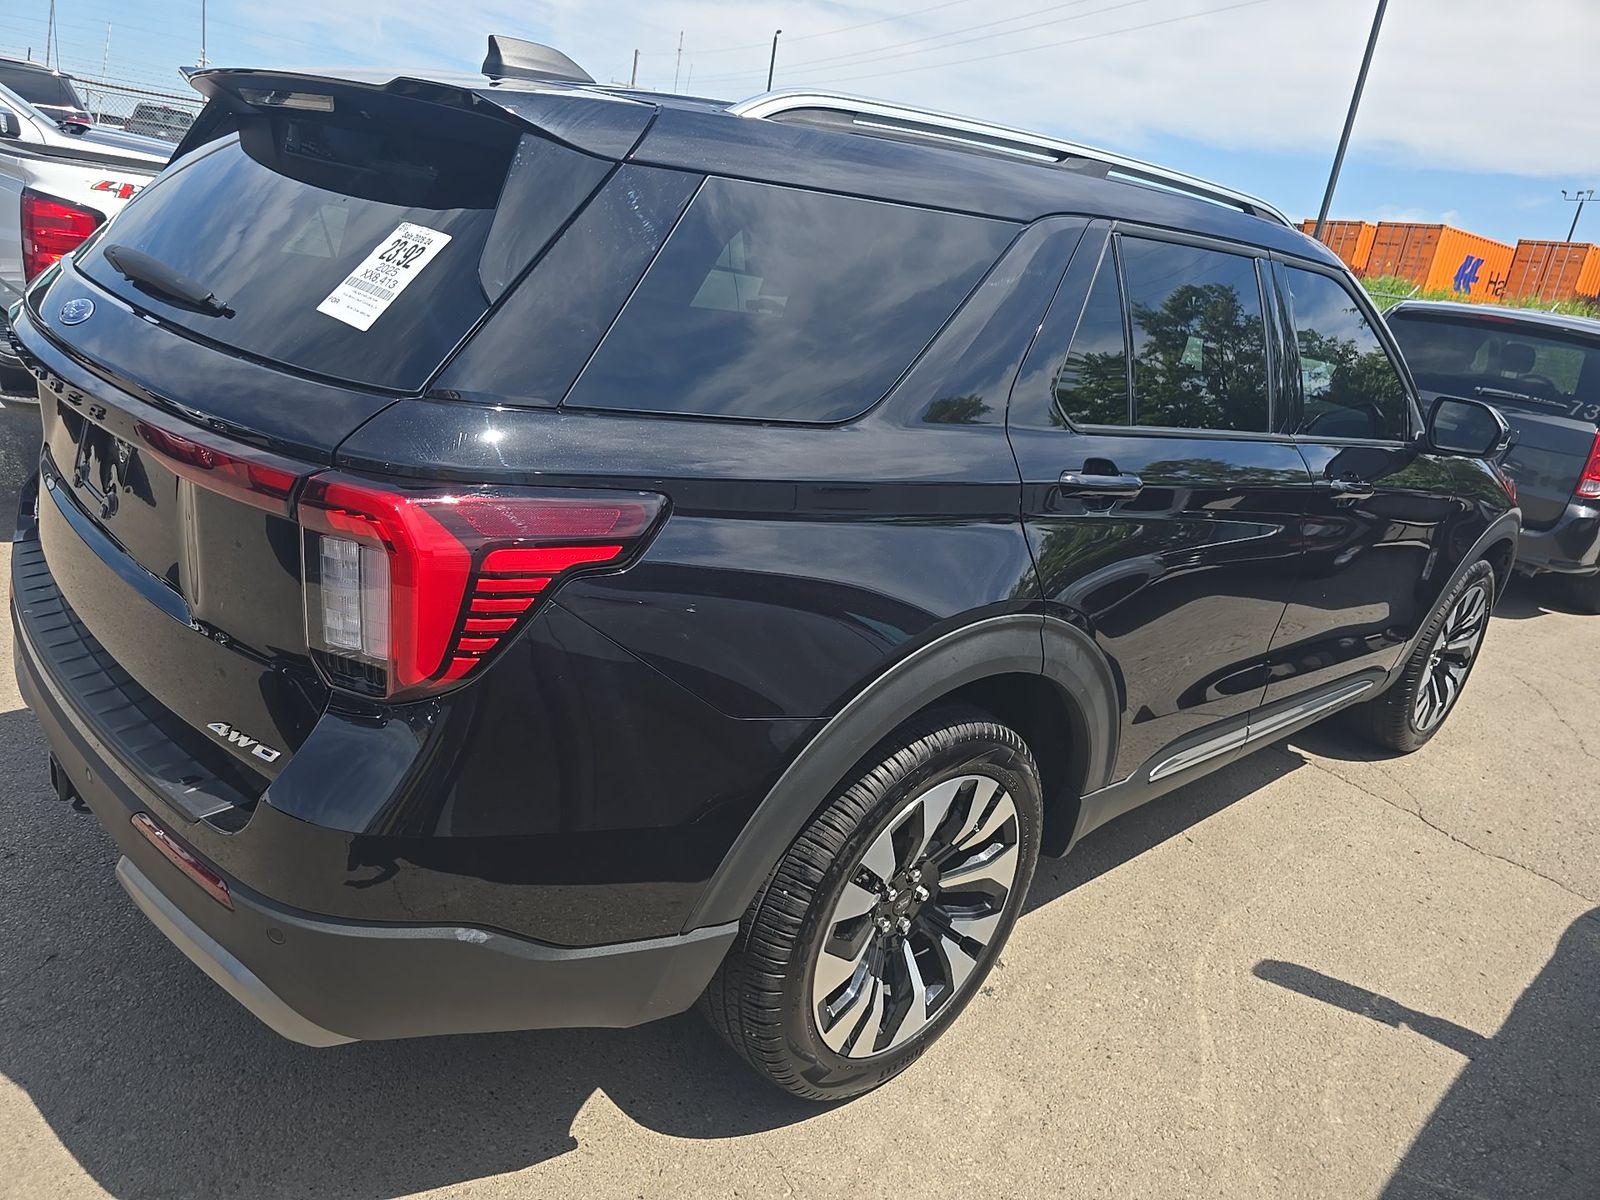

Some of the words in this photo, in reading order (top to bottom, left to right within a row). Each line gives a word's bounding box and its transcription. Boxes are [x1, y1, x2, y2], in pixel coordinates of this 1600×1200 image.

[378, 238, 426, 269] 23:92
[375, 262, 400, 277] 2025
[206, 722, 281, 763] 4WD
